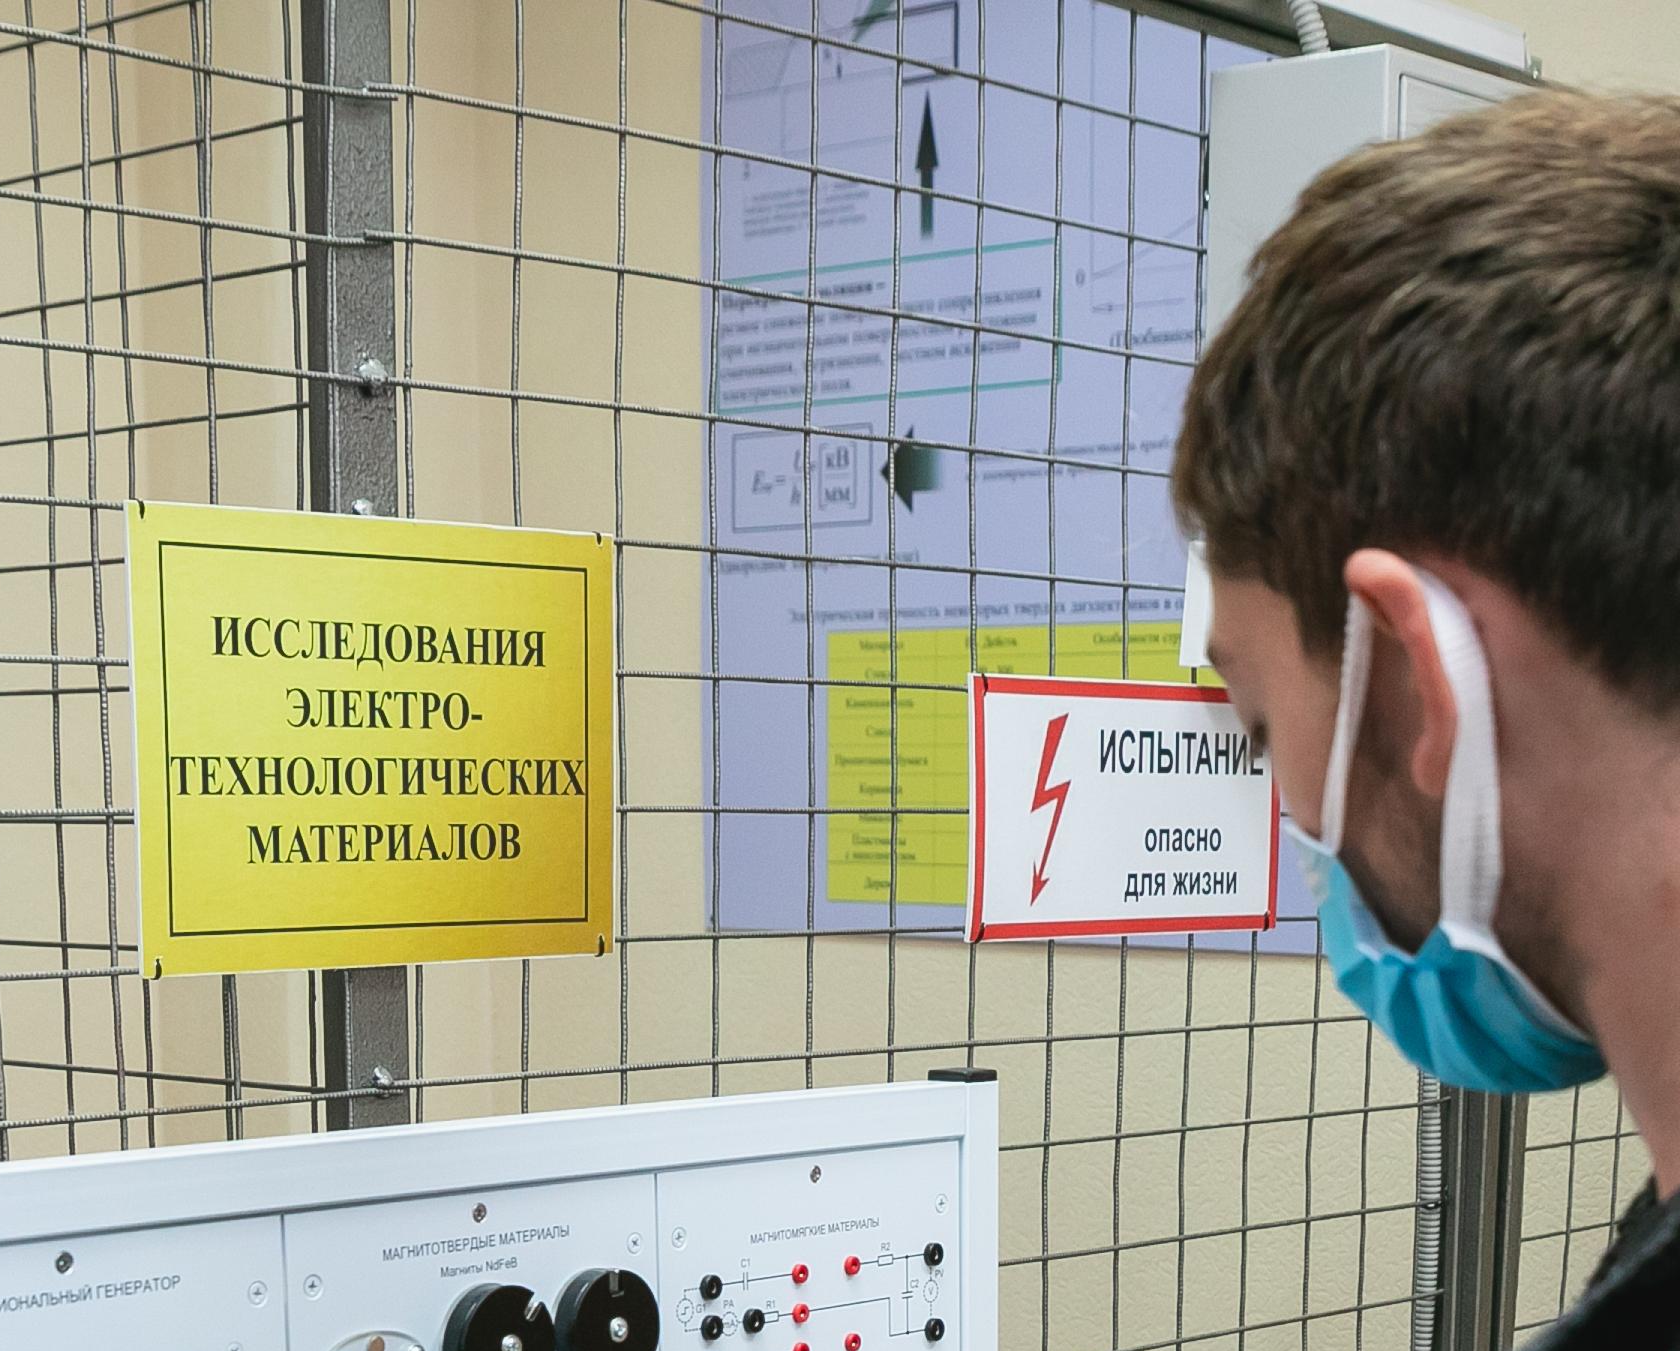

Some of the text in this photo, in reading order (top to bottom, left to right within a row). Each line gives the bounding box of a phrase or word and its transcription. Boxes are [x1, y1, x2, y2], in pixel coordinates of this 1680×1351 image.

[211, 616, 546, 670] ИССЛЕДОВАНИЯ
[286, 688, 483, 730] ЭЛЕКТРО-
[171, 756, 586, 797] ТЕХНОЛОГИЧЕСКИХ
[247, 823, 521, 864] МАТЕРИАЛОВ
[1144, 826, 1222, 856] опасно
[1124, 869, 1238, 902] для жизни
[382, 1224, 570, 1262] МАГНИТОТВЕРДЫЕ МАТЕРИАЛЫ
[750, 1217, 880, 1244] МАГНИТОМЯГКИЕ МАТЕРИАЛЫ
[440, 1257, 518, 1278] Магниты NdFeB
[96, 1274, 181, 1301] ГЕНЕРАТОР
